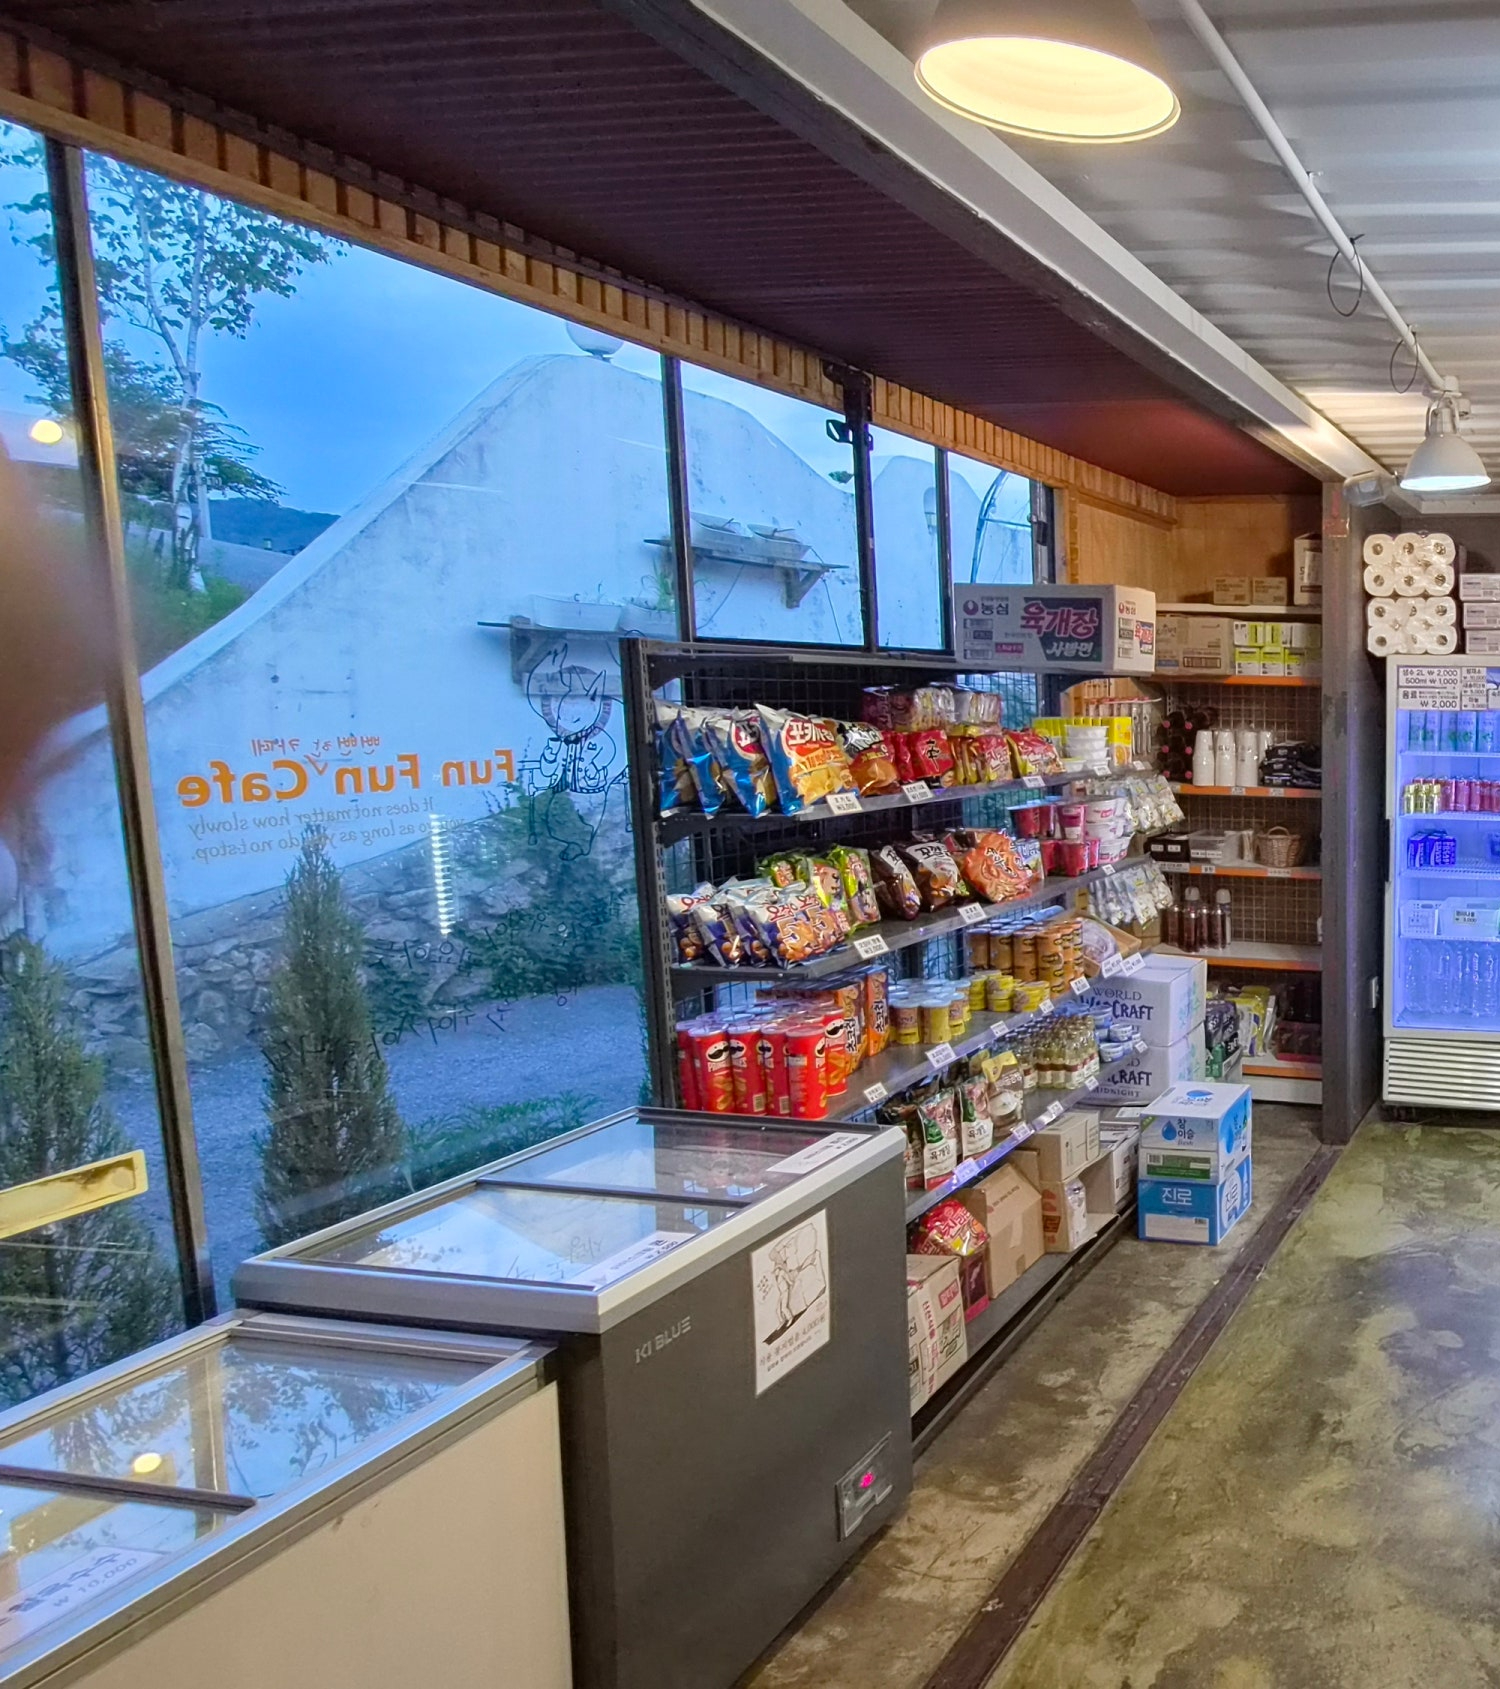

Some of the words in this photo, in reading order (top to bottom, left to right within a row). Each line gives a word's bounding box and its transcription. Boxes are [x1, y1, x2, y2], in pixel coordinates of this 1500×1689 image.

[981, 602, 1009, 616] 농심
[1020, 600, 1099, 639] 육개장
[1046, 641, 1093, 658] 사발면
[1432, 701, 1457, 709] 2,000
[1092, 986, 1142, 1001] WORLD
[1177, 1128, 1195, 1140] 이슬
[1162, 1187, 1193, 1206] 진로
[654, 1315, 692, 1351] BLUE
